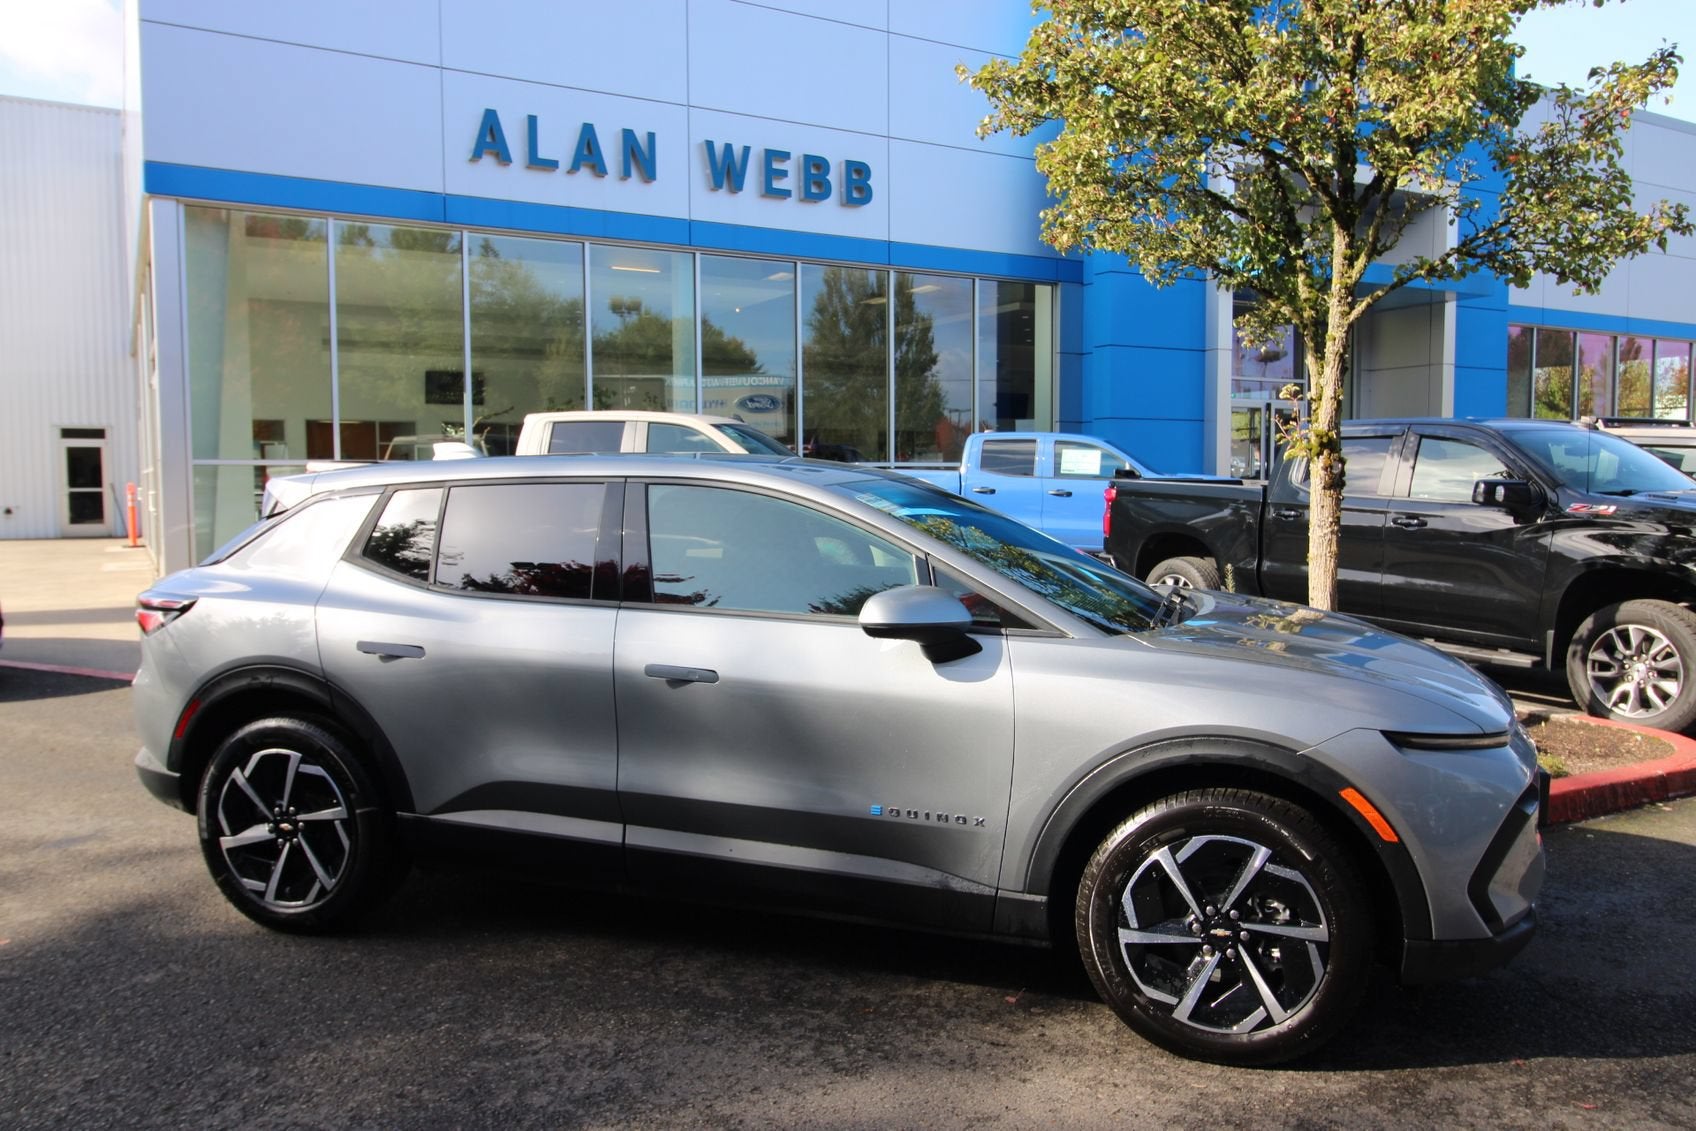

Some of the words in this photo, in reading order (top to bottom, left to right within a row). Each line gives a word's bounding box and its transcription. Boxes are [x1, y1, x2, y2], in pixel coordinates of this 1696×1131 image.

[469, 107, 657, 184] ALAN
[703, 139, 874, 208] WEBB
[870, 804, 985, 827] EQUINOX
